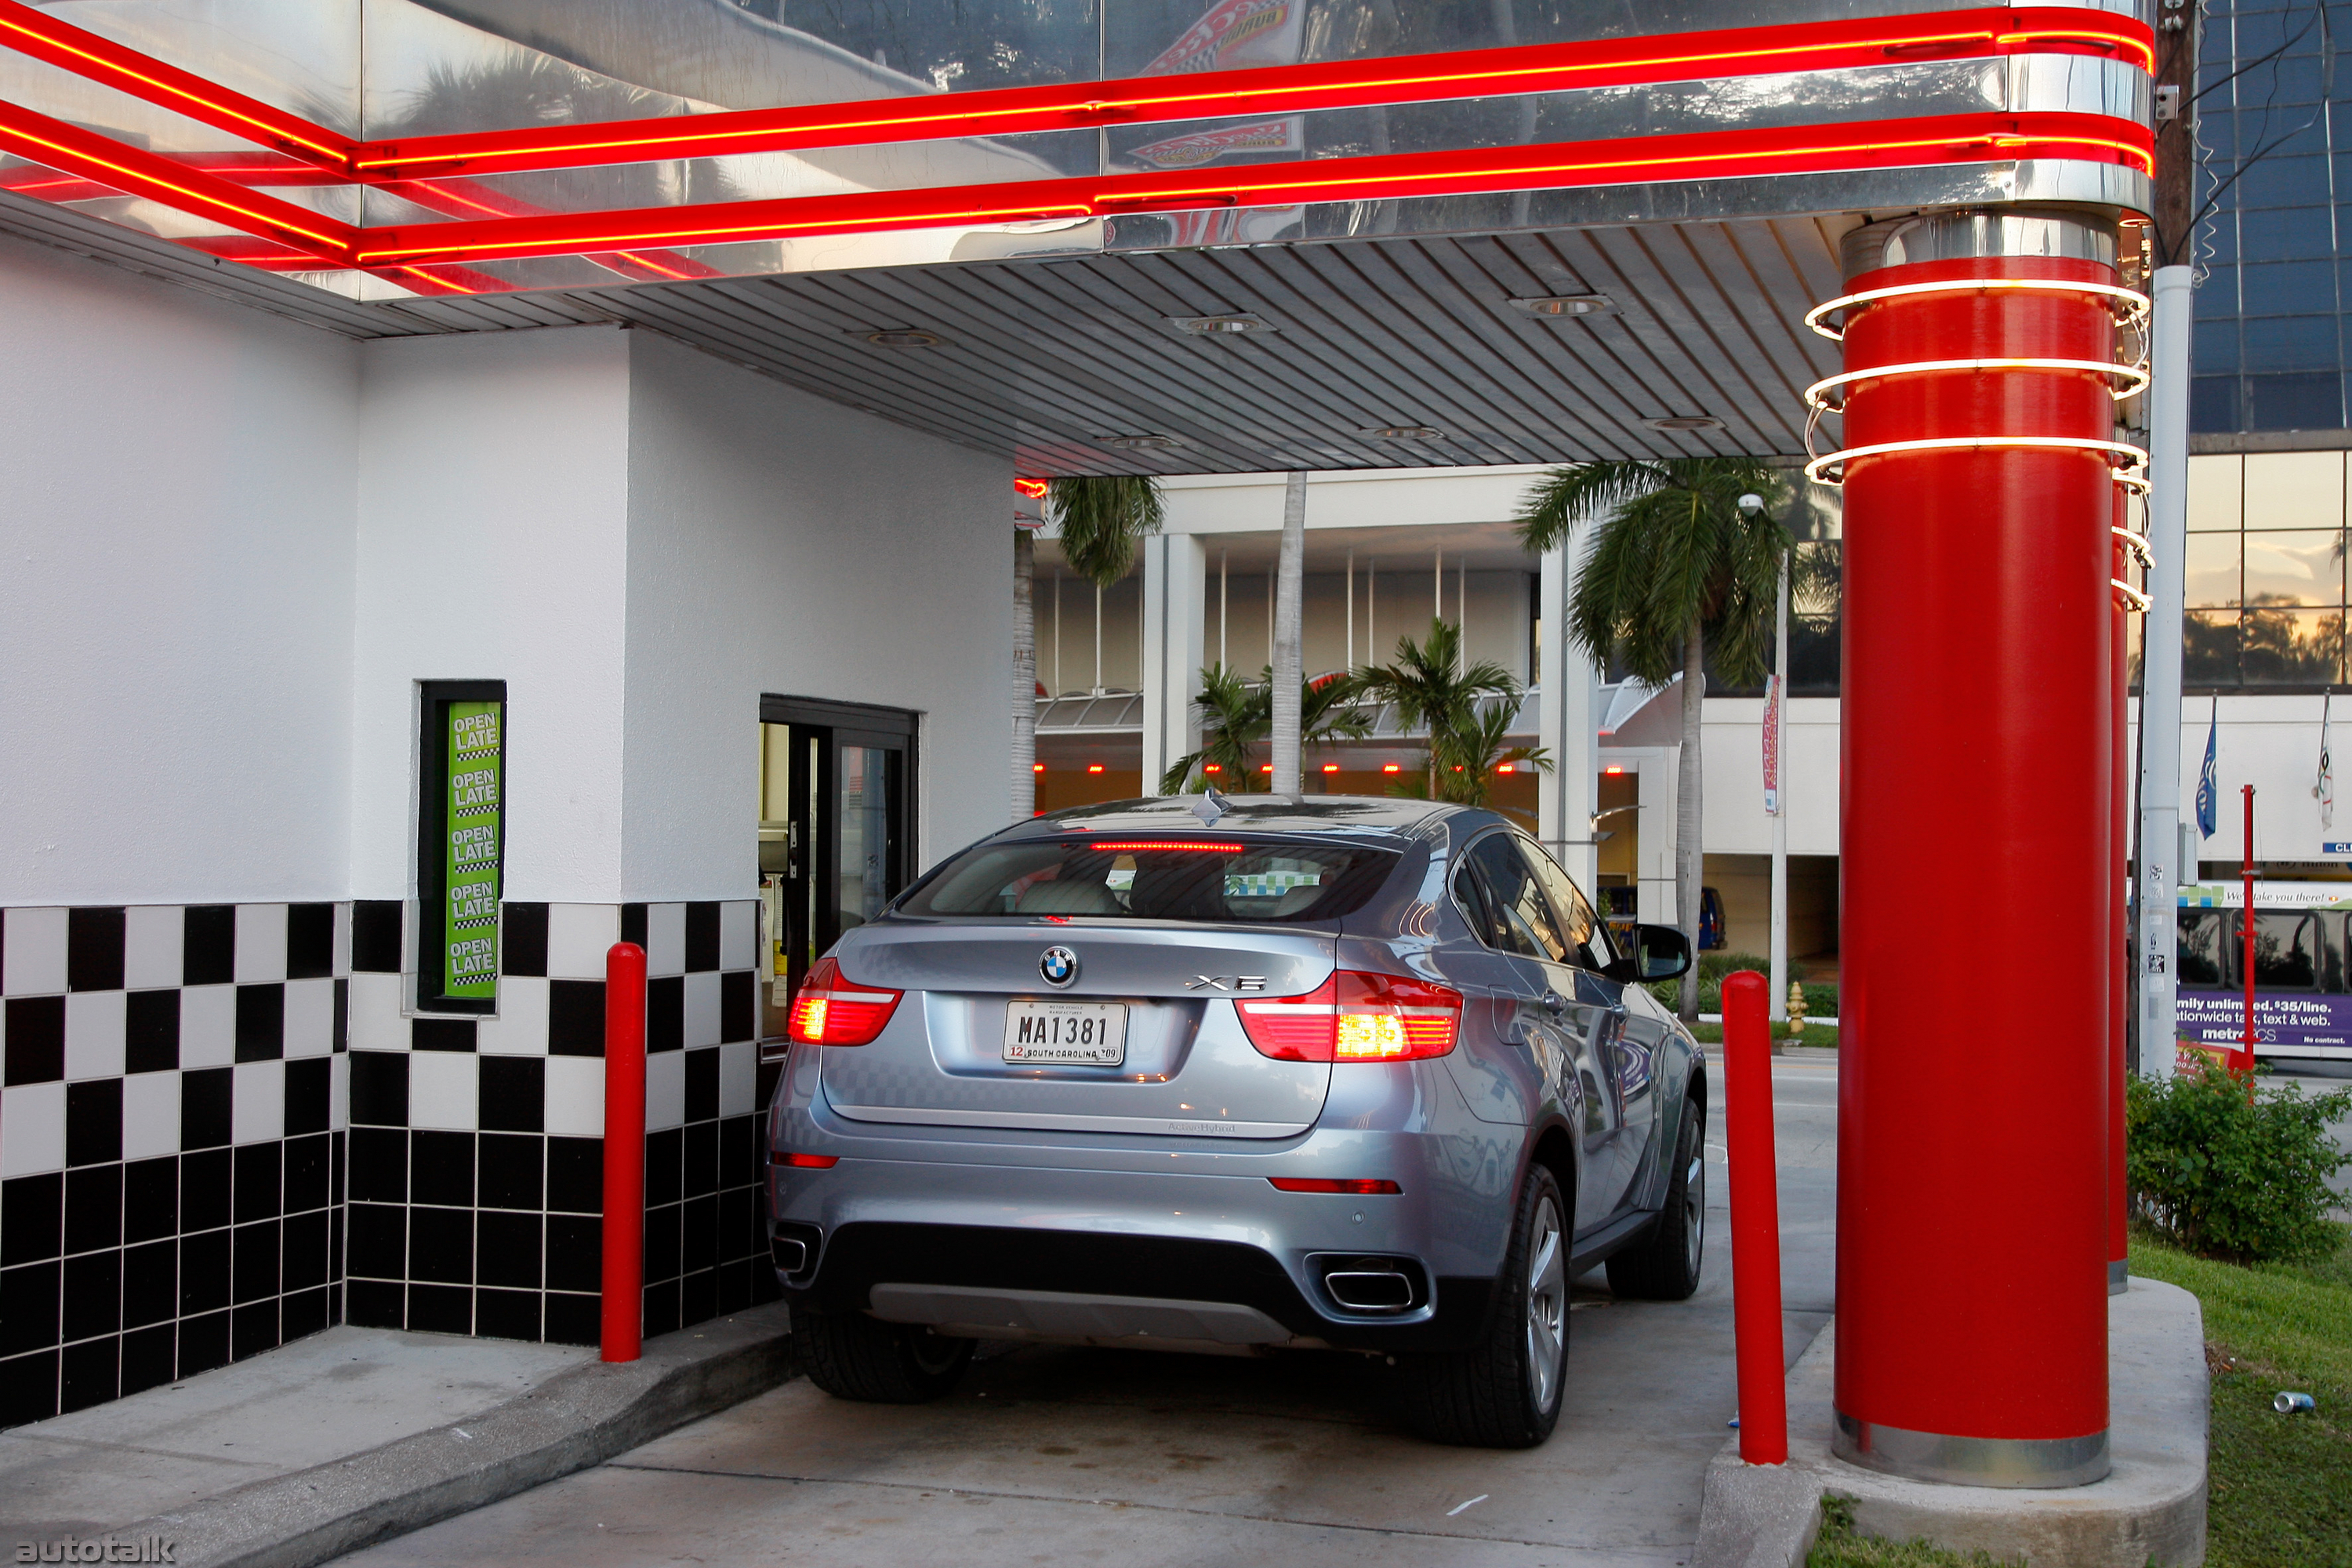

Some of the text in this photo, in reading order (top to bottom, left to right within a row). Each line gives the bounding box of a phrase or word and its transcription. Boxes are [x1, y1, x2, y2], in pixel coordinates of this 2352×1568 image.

[453, 712, 496, 732] OPEN
[455, 728, 499, 750] LATE
[452, 768, 495, 789] OPEN
[455, 784, 497, 806] LATE
[452, 825, 494, 845] OPEN
[453, 840, 496, 862] LATE
[2336, 843, 2352, 852] CL
[451, 881, 493, 901] OPEN
[2253, 892, 2272, 902] take
[2275, 895, 2292, 904] you
[2296, 893, 2325, 902] there!
[452, 897, 495, 918] LATE
[450, 938, 492, 956] OPEN
[1045, 949, 1071, 962] BMW
[452, 953, 495, 975] LATE
[2176, 998, 2332, 1013] mily unlimed. $35/line.
[2176, 1010, 2331, 1026] ationwide tak, text & web.
[1018, 1016, 1107, 1045] MA1381
[1011, 1047, 1023, 1056] 12
[1105, 1048, 1116, 1058] 09
[1168, 1123, 1236, 1133] ActiveHybrid
